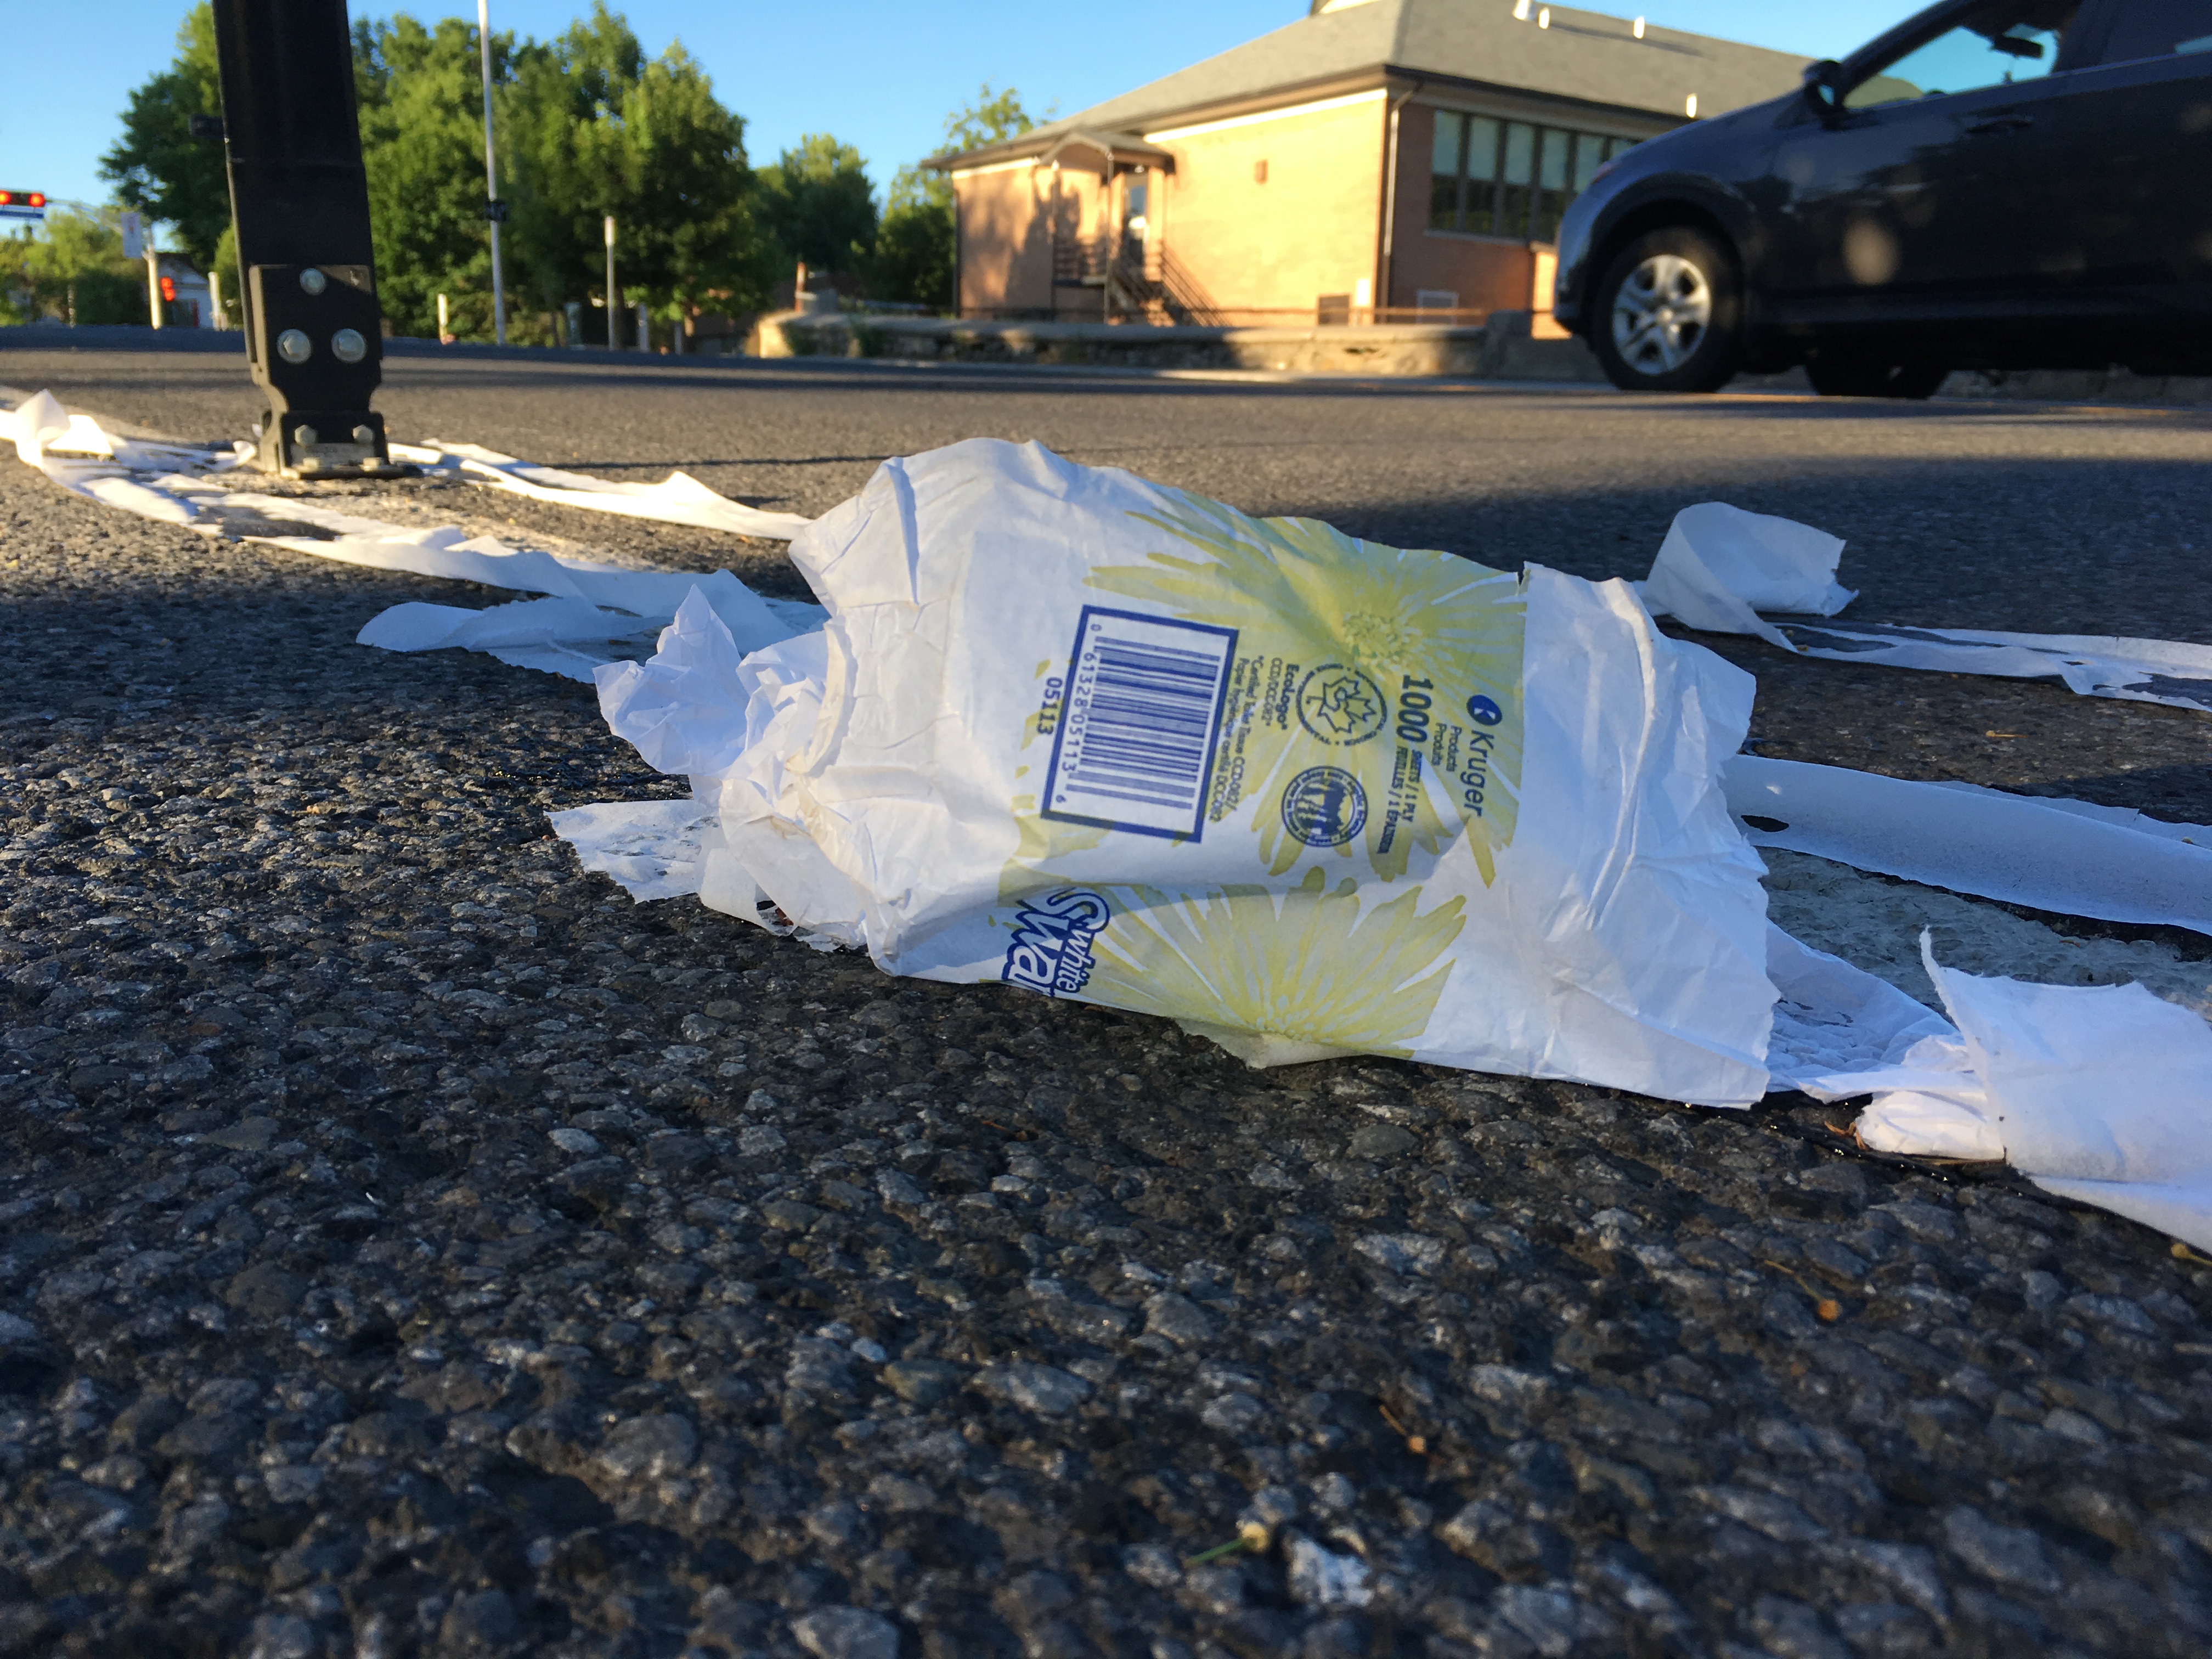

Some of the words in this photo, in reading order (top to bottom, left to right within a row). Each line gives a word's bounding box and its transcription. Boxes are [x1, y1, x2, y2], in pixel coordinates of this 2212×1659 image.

[1090, 623, 1102, 632] 0
[1036, 676, 1063, 736] 05113
[1396, 674, 1434, 743] 1000
[1446, 725, 1462, 772] Products
[1460, 729, 1494, 817] Kruger
[1056, 794, 1067, 804] 6
[1402, 802, 1417, 823] PLY
[1054, 929, 1094, 992] white
